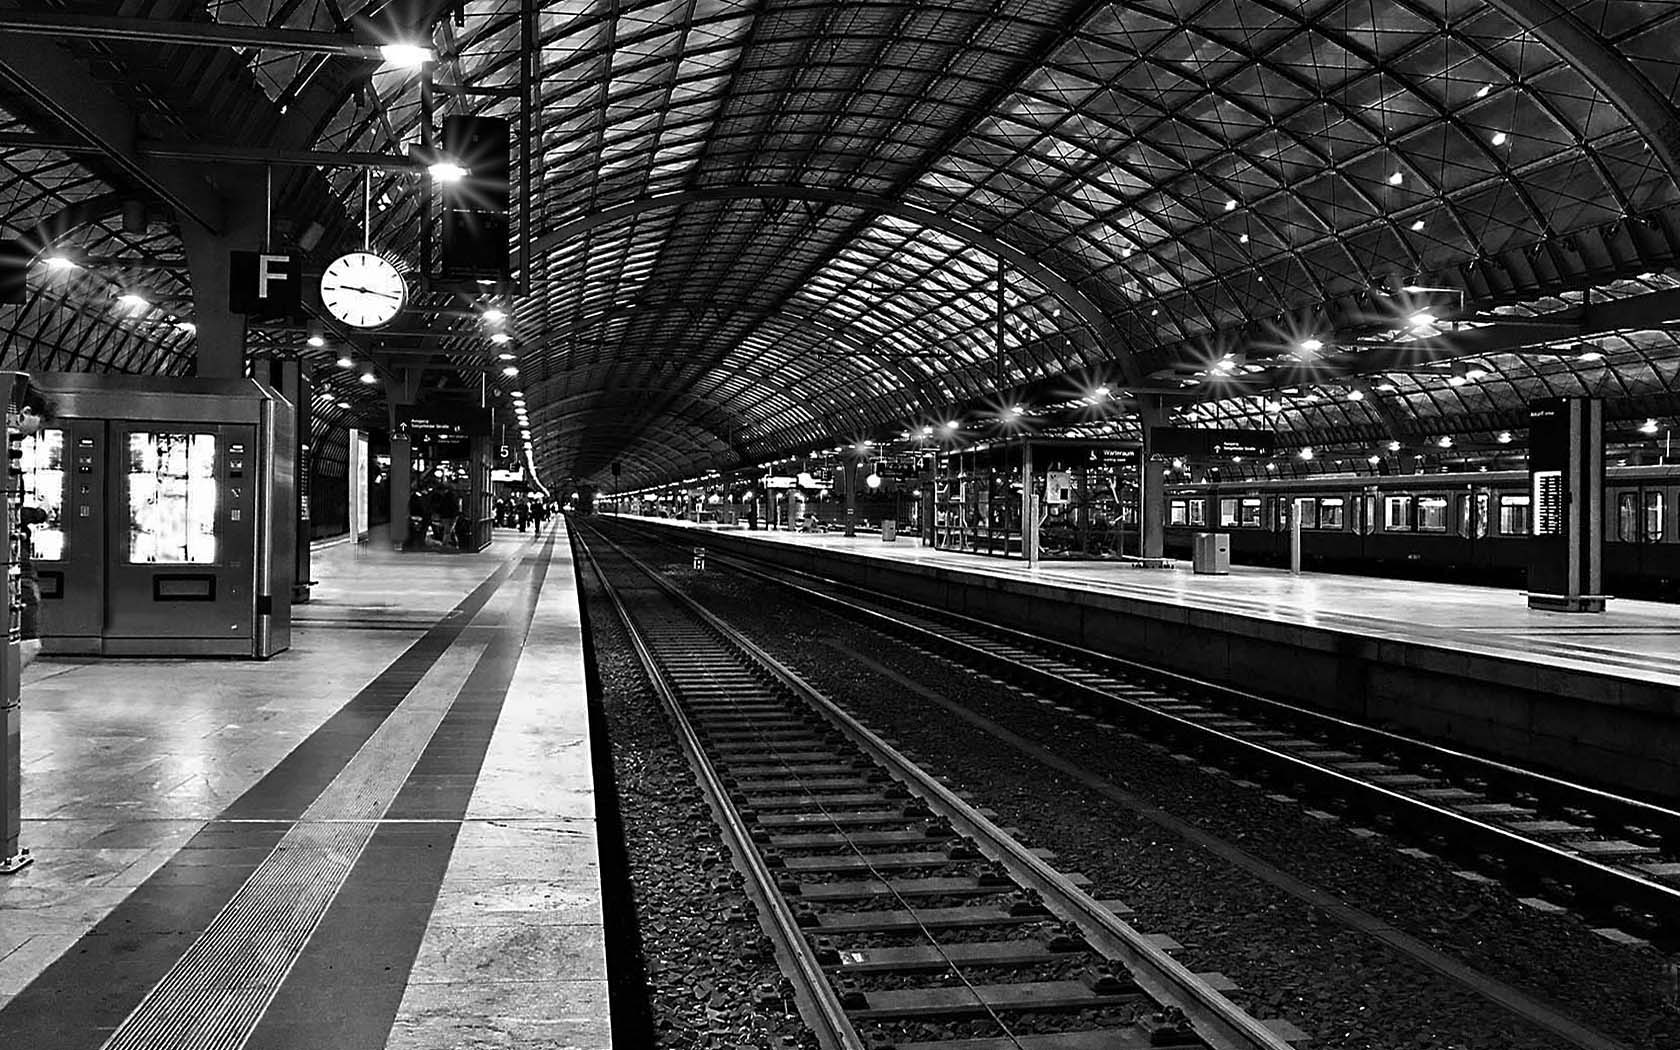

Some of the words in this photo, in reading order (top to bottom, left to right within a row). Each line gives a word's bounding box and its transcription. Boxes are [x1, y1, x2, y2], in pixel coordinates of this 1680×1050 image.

[259, 254, 290, 298] F
[500, 445, 509, 458] 5
[916, 457, 924, 469] 4
